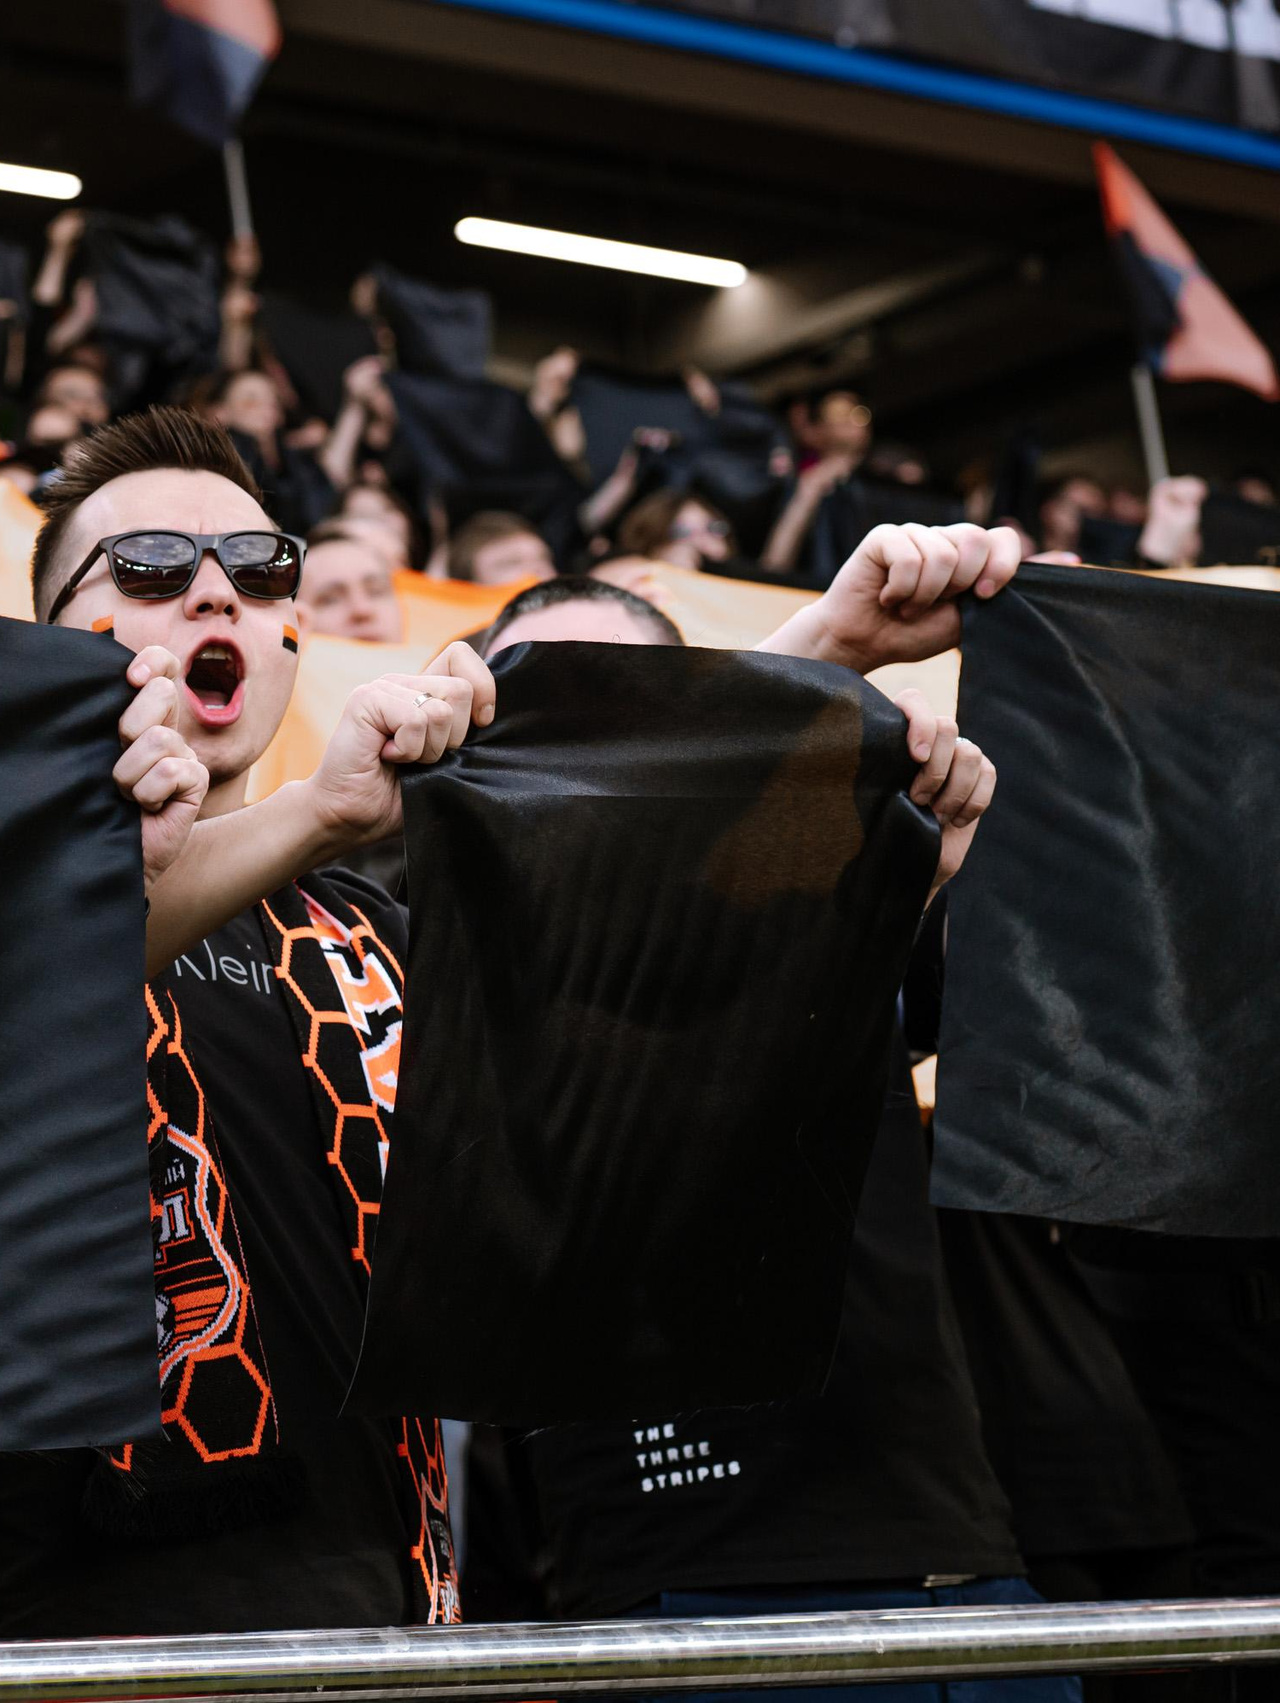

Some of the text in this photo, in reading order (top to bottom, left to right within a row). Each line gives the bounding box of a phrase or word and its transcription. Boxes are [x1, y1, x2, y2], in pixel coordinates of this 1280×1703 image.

[634, 1423, 675, 1444] THE
[636, 1441, 710, 1468] THREE
[641, 1460, 741, 1492] STRIPES
